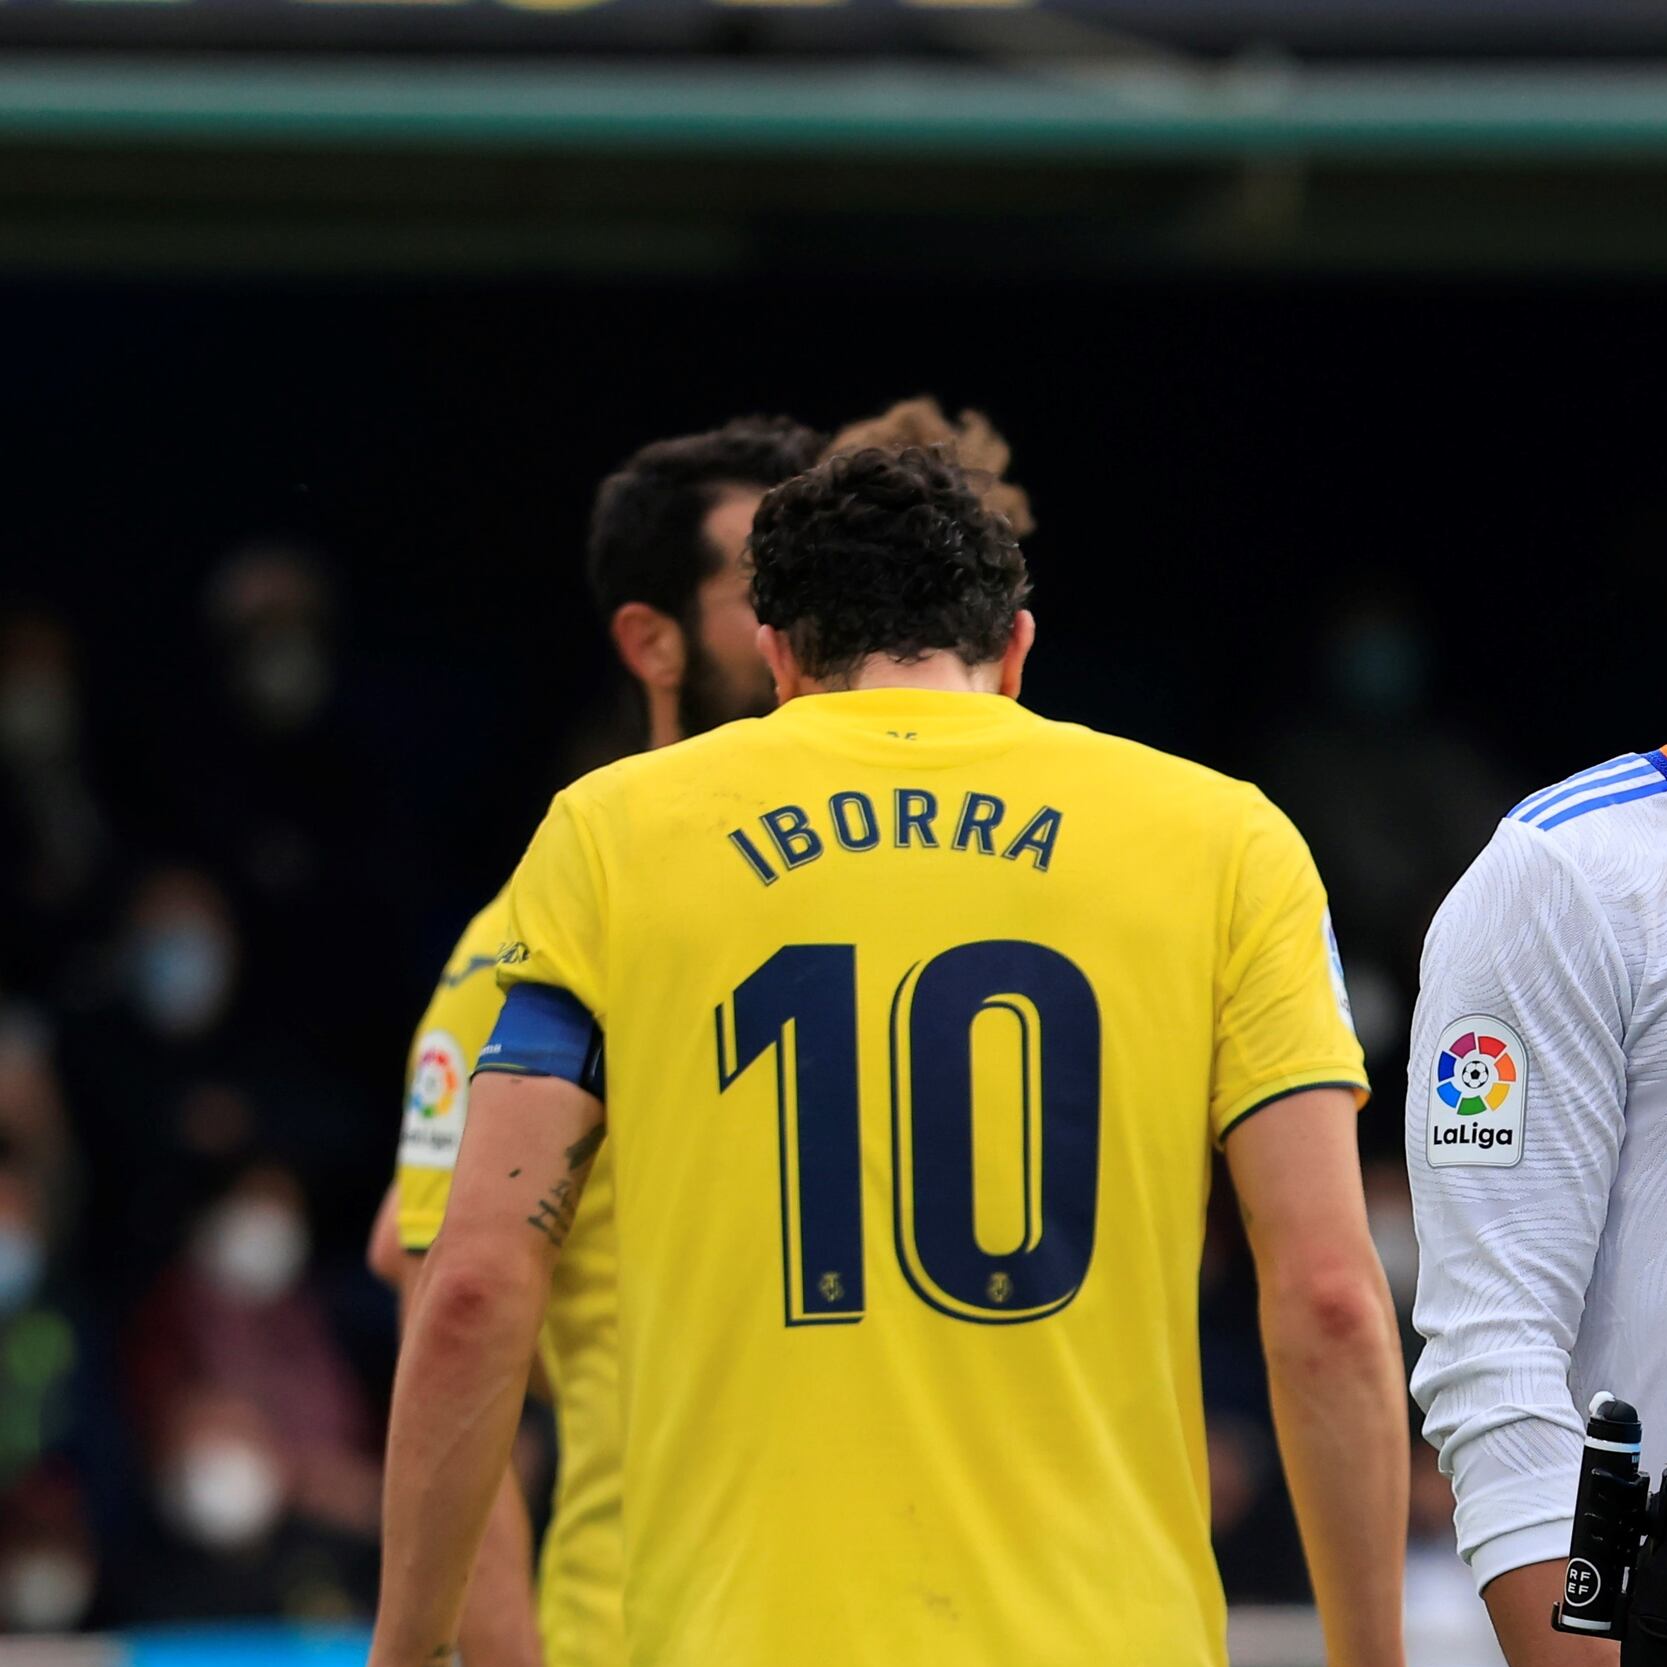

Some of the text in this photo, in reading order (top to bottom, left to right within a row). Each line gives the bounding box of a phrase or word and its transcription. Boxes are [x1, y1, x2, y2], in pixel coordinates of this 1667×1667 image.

[728, 788, 1064, 887] IBORRA
[714, 939, 1101, 1328] 10
[1433, 1121, 1513, 1149] LaLiga
[1570, 1568, 1591, 1582] RF
[1567, 1583, 1590, 1596] EF
